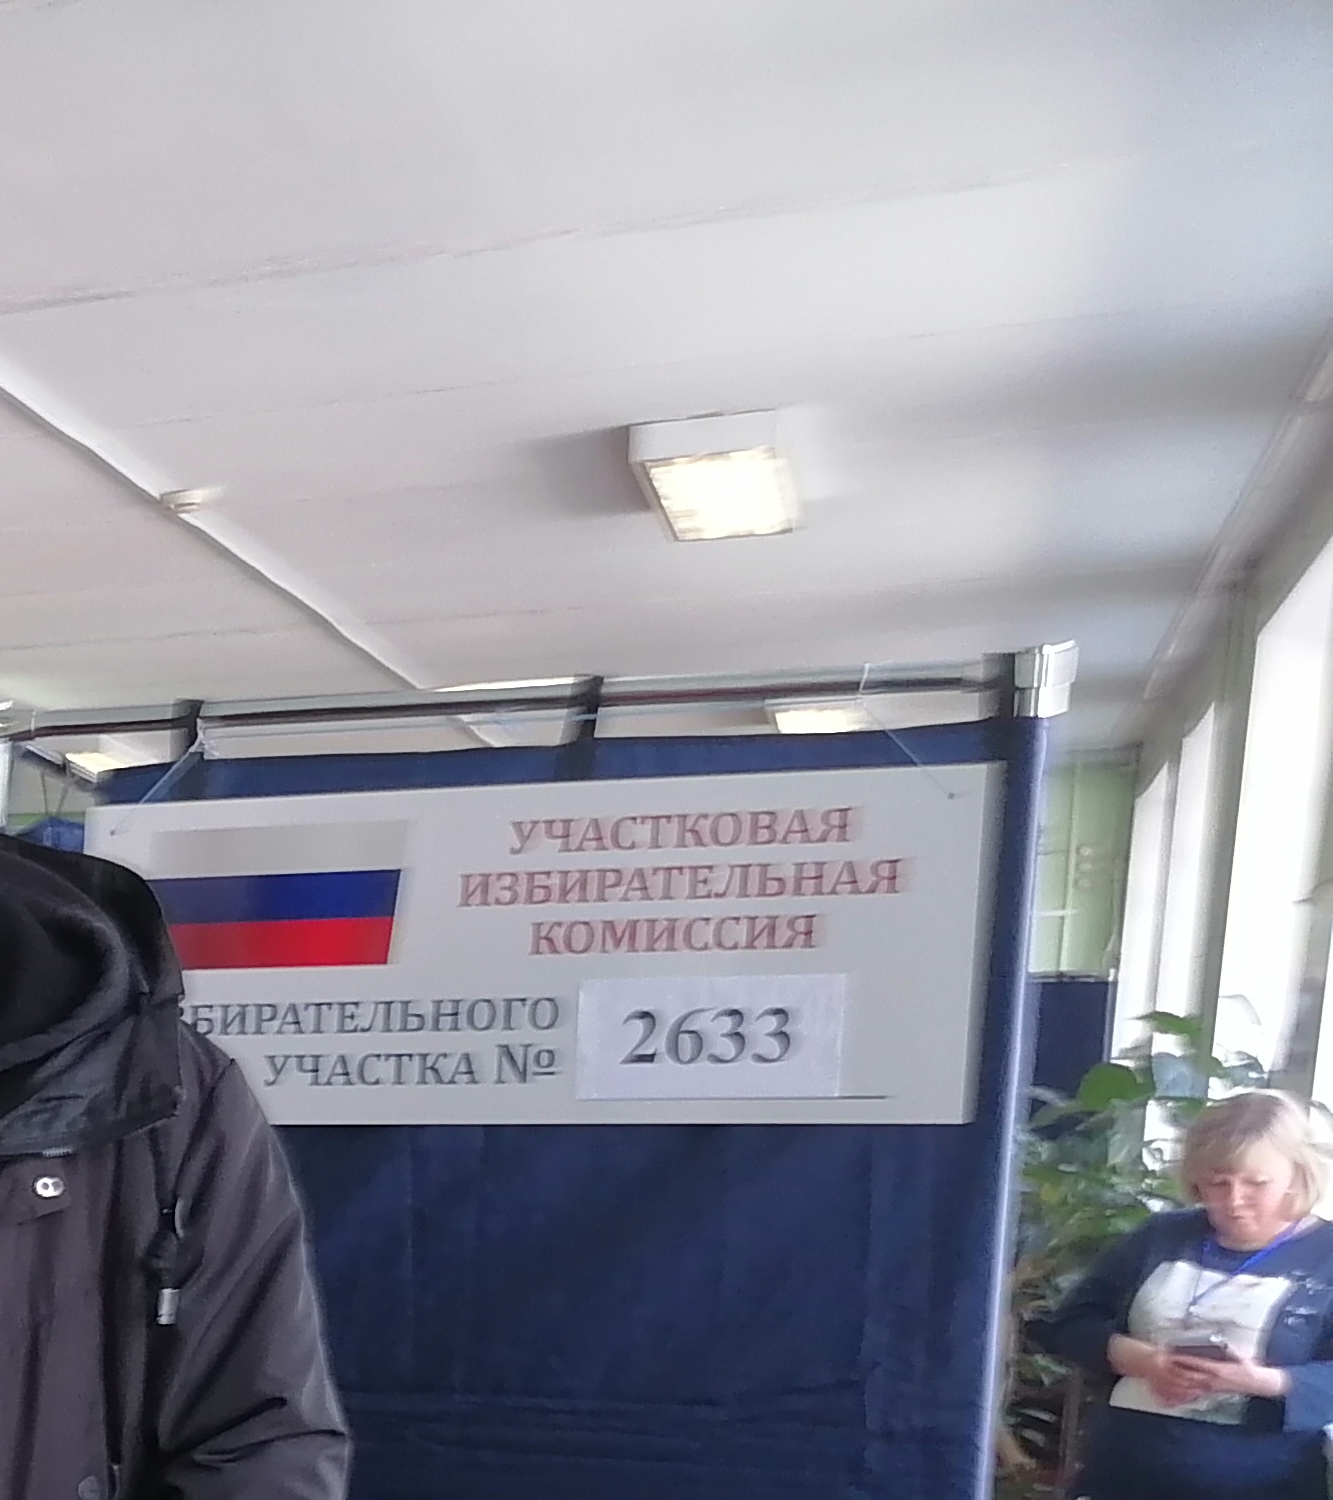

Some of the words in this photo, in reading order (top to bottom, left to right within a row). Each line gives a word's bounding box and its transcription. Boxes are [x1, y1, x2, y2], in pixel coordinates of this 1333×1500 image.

[509, 806, 855, 856] УЧАСТКОВАЯ
[456, 857, 903, 908] ИЗБИРАТЕЛЬНАЯ
[528, 913, 819, 956] КОМИССИЯ
[179, 996, 560, 1037] БИРАТЕЛЬНОГО
[263, 1051, 479, 1088] УЧАСТКА
[494, 1043, 563, 1085] №
[619, 1005, 792, 1066] 2633
